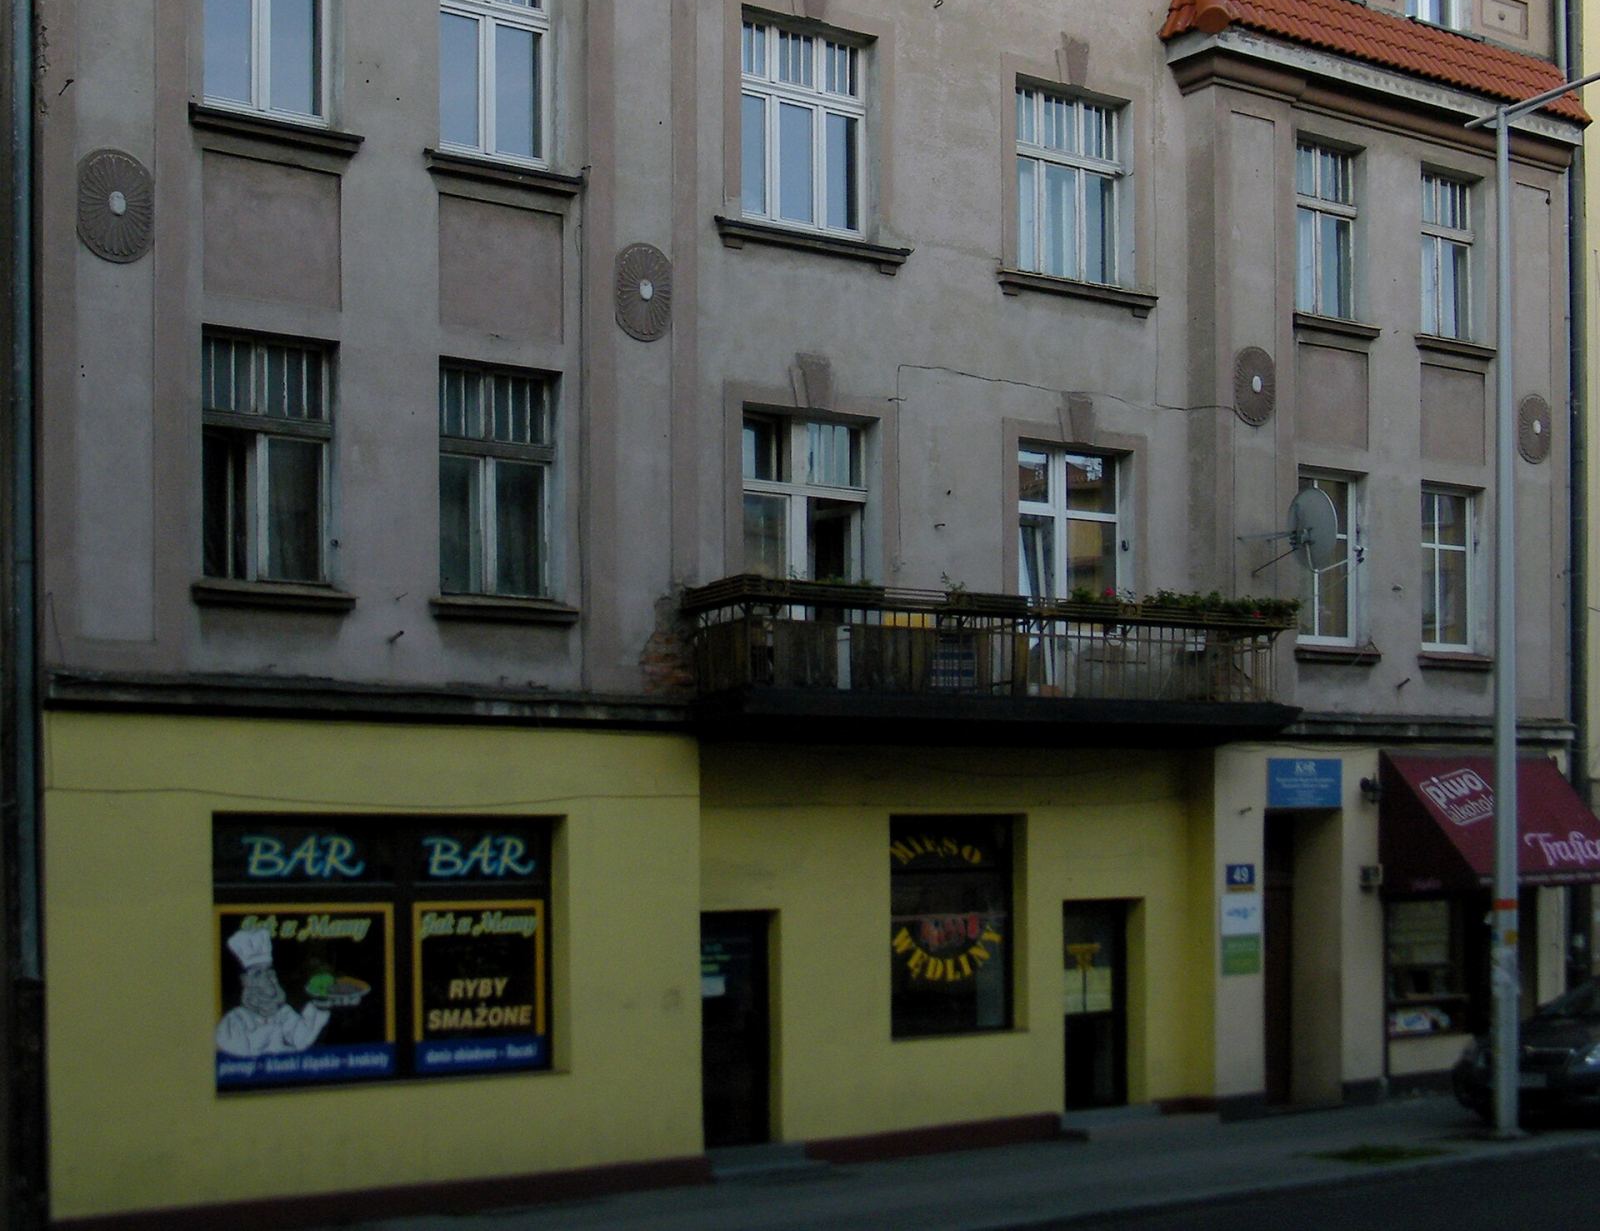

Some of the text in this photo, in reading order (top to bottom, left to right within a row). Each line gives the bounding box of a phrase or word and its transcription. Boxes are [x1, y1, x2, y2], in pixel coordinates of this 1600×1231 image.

[1425, 773, 1484, 810] piwo
[240, 832, 367, 879] BAR
[421, 833, 537, 878] BAR
[1232, 866, 1249, 883] 49
[296, 914, 371, 942] Mamy
[418, 913, 455, 940] Jak
[472, 911, 537, 937] Mamy
[893, 924, 1003, 982] WĘDLINY
[449, 977, 508, 1000] RYBY
[428, 1001, 533, 1031] SMAŻONE
